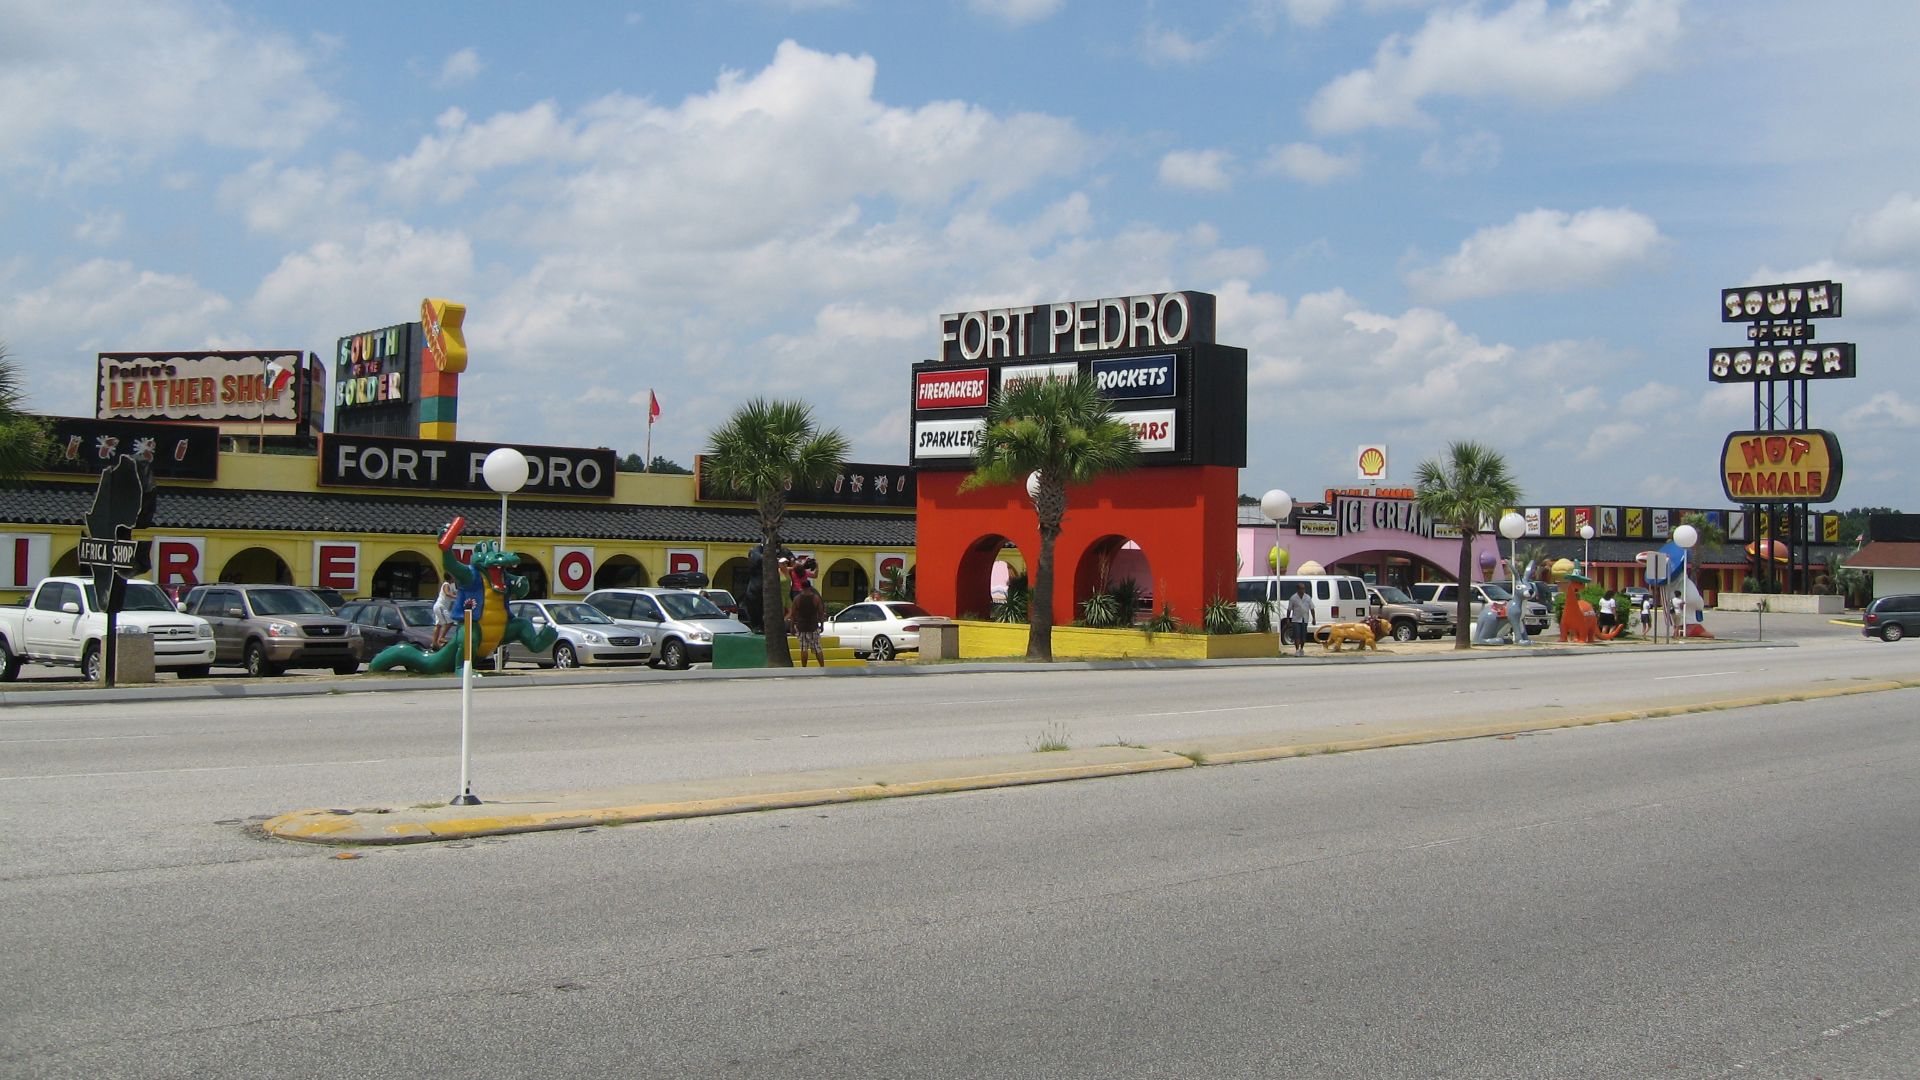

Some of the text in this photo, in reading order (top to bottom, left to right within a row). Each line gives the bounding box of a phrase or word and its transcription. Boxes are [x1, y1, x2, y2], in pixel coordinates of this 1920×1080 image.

[1725, 285, 1830, 318] SOUTH
[939, 292, 1190, 362] FORT PEDRO
[1748, 326, 1803, 338] OF THE
[340, 328, 400, 366] SOUTH
[1712, 347, 1841, 377] BORDER
[109, 364, 177, 379] Pedro's
[1097, 366, 1168, 390] ROCKETS
[110, 376, 217, 410] LEATHER
[336, 372, 401, 407] BORDER
[919, 380, 984, 400] FIRECRACKERS
[919, 430, 981, 448] SPARKLERS
[1123, 421, 1169, 440] TARS
[338, 445, 601, 489] FORT PDRO
[1740, 437, 1810, 469] HOT
[1728, 471, 1821, 496] TAMALE
[1340, 499, 1432, 540] ICE CREAM
[81, 542, 133, 563] AFRICA SHOP
